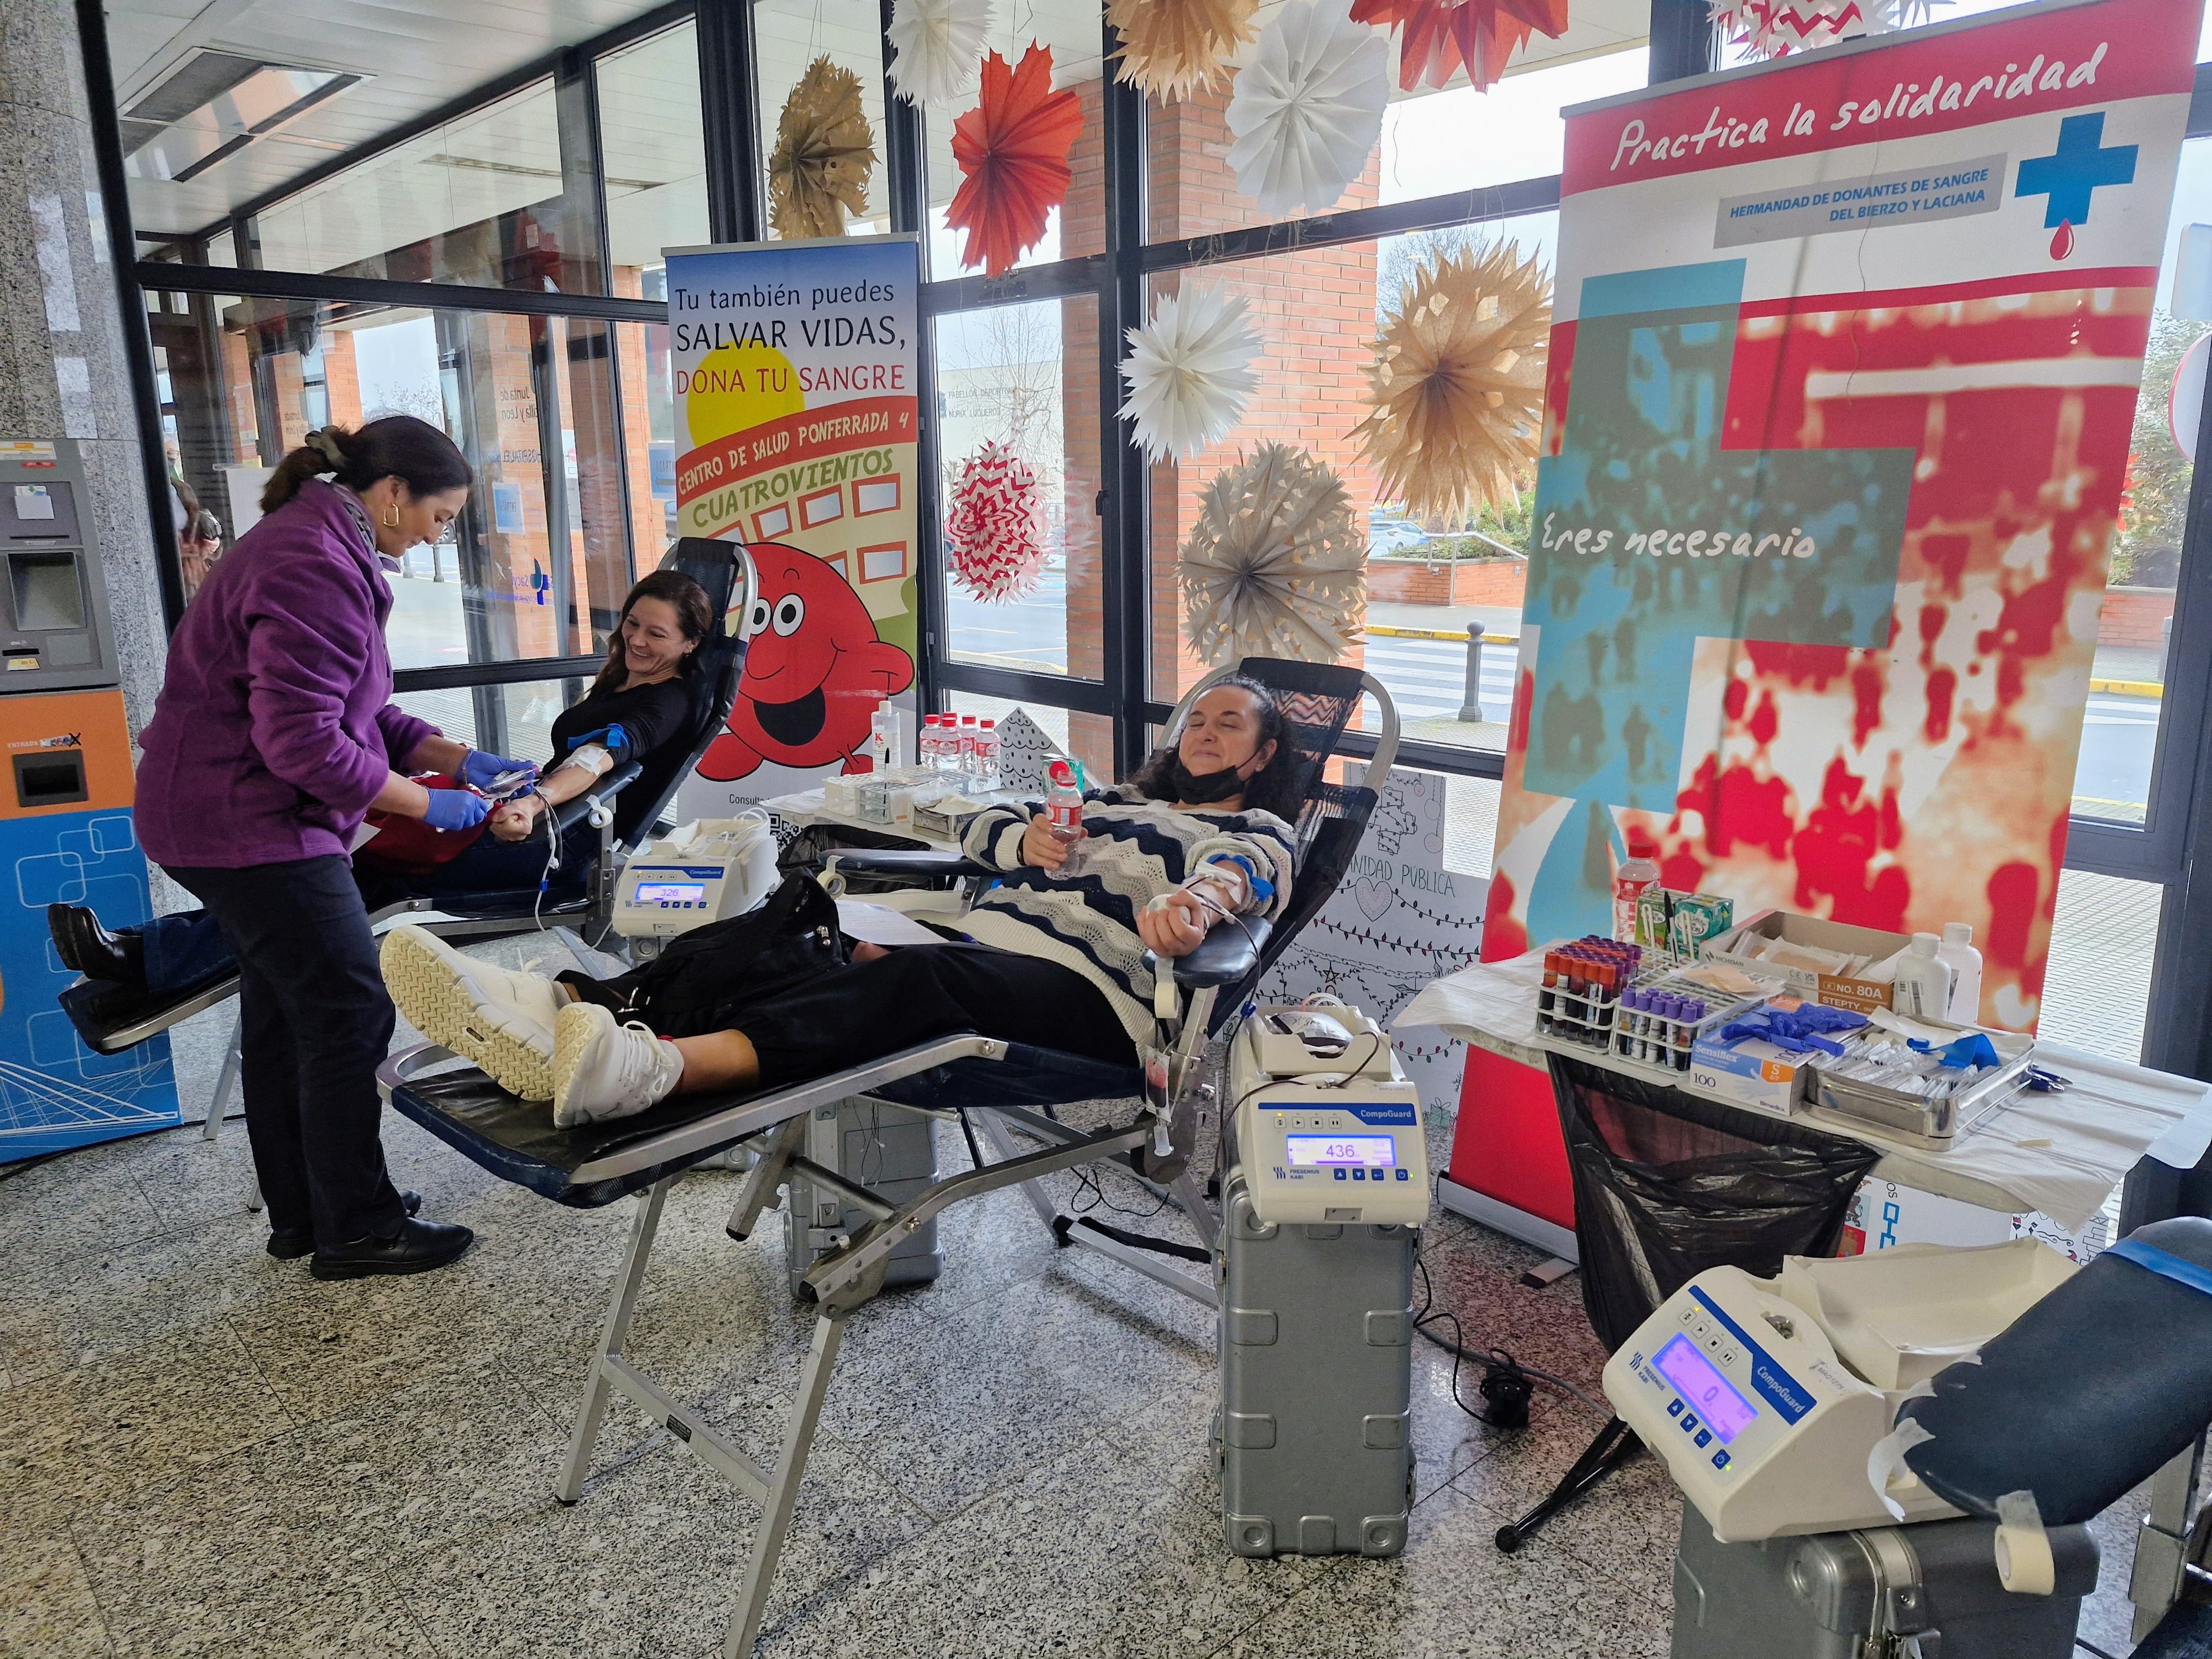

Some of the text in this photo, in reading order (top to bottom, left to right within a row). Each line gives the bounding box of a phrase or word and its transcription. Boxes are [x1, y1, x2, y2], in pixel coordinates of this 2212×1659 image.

[1610, 42, 2108, 171] Practica la solidaridad
[1729, 168, 1989, 218] HERMANDAD DE DONANTES DE SANGRE
[1829, 189, 1985, 222] DEL BIERZO Y LACIANA
[675, 279, 895, 311] Tu también puedes
[676, 316, 906, 352] SALVAR VIDAS,
[676, 364, 906, 395] DONA TU SANGRE
[678, 411, 909, 495] CENTRO DE SALUD PONFERRADA 4
[692, 447, 893, 528] CUATROVIENTOS
[1541, 512, 1815, 558] Eres necesario
[660, 889, 679, 897] 326
[1401, 864, 1455, 899] PÚBLICA
[1715, 956, 1744, 967] NICHIBAN
[1822, 996, 1860, 1010] STEPTY
[1837, 984, 1883, 1000] NO. 80A
[1695, 1044, 1738, 1063] Sensiflex
[1693, 1072, 1717, 1088] 100
[1771, 1063, 1780, 1076] S
[1360, 1109, 1412, 1119] CompoGuard
[1326, 1144, 1355, 1158] 436
[1637, 1371, 1650, 1384] KABI
[1642, 1365, 1666, 1392] FRESENIUS
[1757, 1366, 1806, 1413] CompoGuard
[1703, 1386, 1719, 1402] 0
